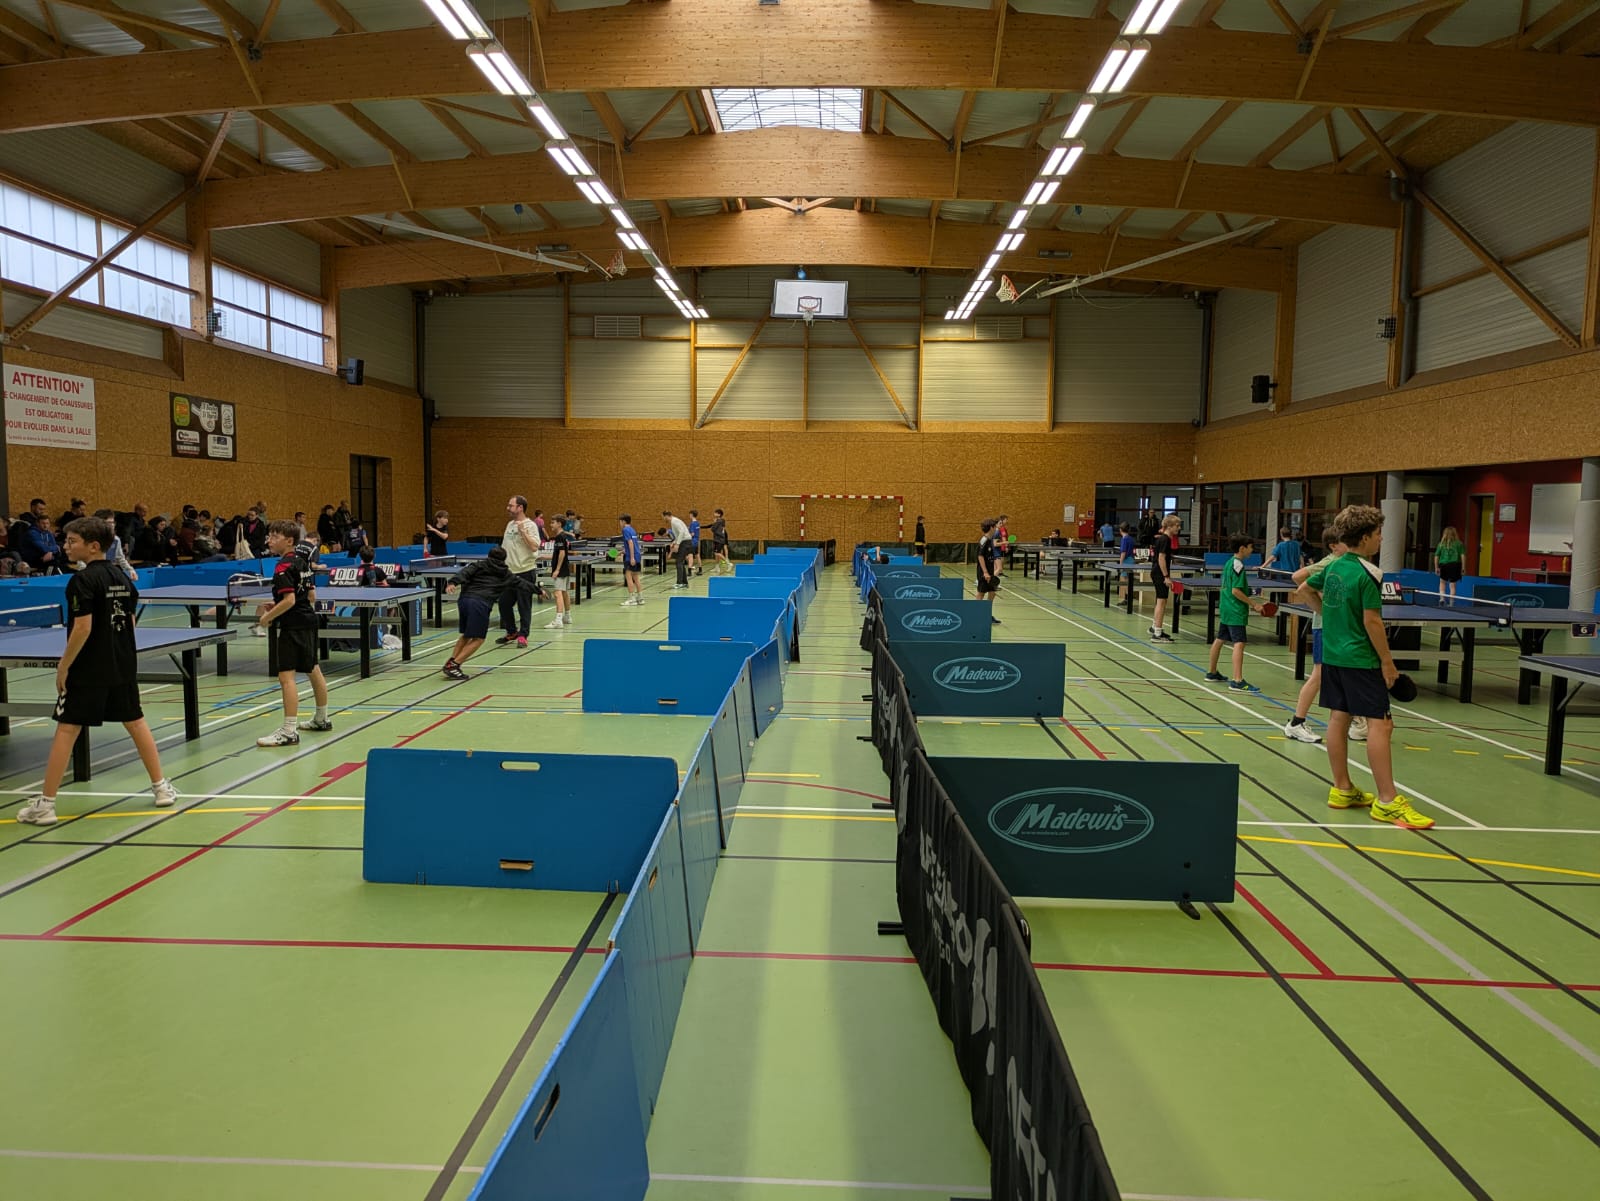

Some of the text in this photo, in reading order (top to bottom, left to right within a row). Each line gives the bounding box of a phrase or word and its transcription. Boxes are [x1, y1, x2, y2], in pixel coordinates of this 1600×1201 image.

[9, 391, 50, 404] CHANGEMENT
[51, 398, 59, 406] DE
[59, 398, 93, 410] CHAUSSURES
[25, 408, 73, 421] EST OBLIGATOIRE
[23, 421, 50, 432] EVOLUER
[50, 424, 66, 434] DANS
[67, 426, 74, 435] LA
[75, 427, 92, 436] SALLE
[910, 615, 952, 628] Madewis
[1581, 626, 1587, 634] 6
[944, 666, 1007, 684] Madewis
[1008, 803, 1128, 835] Madewis
